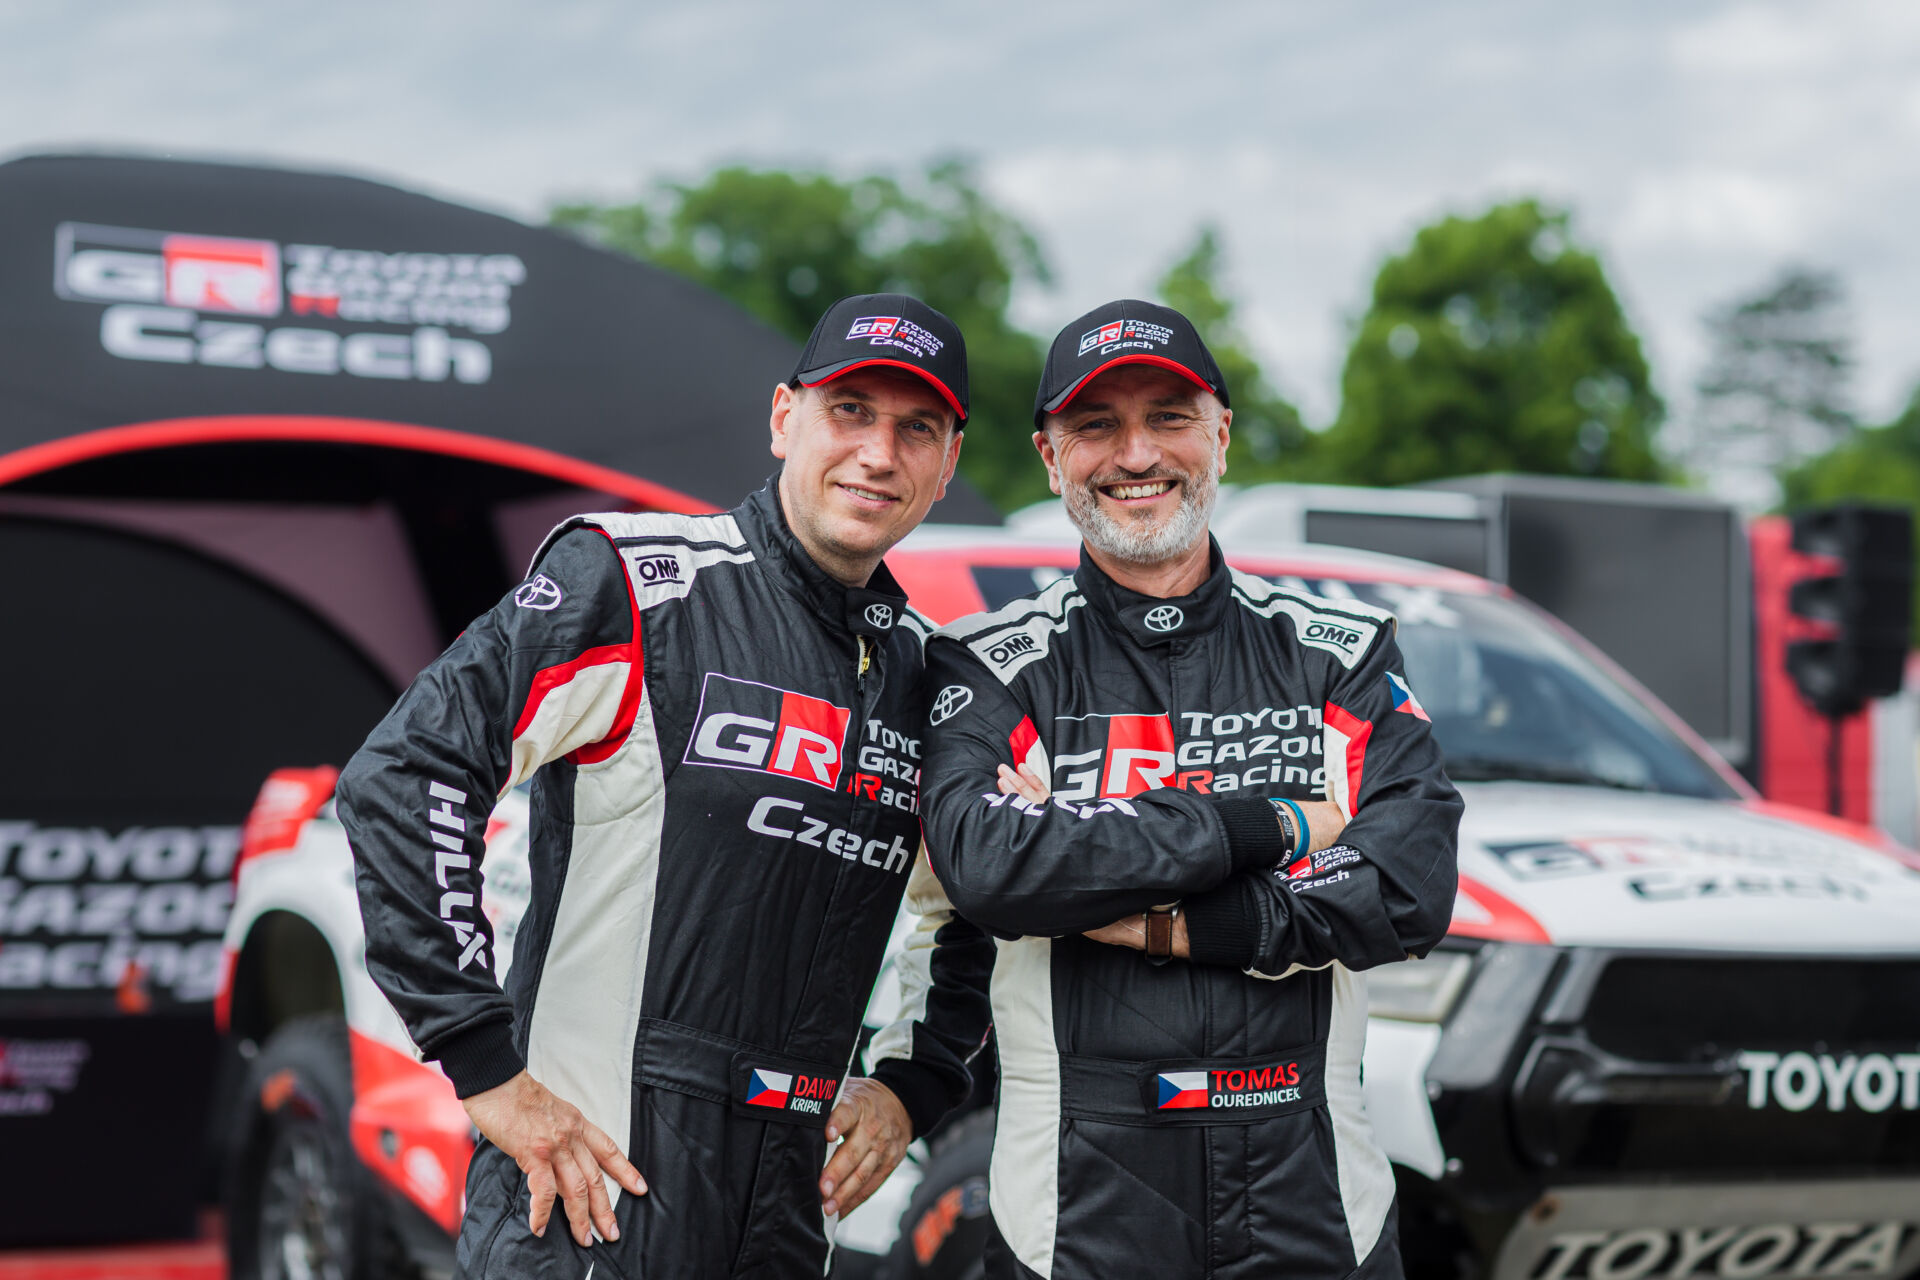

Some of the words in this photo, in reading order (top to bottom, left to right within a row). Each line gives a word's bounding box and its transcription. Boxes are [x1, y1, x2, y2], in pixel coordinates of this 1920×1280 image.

[898, 326, 940, 352] GAZOO
[902, 319, 945, 349] TOYOTA
[1123, 331, 1169, 345] Racing
[1125, 325, 1170, 339] GAZOO
[1126, 319, 1174, 335] TOYOTA
[101, 303, 492, 384] Czech
[869, 336, 924, 359] Czech
[894, 331, 937, 356] Racing
[1101, 340, 1154, 355] Czech
[638, 559, 680, 581] OMP
[1305, 624, 1360, 646] OMP
[989, 635, 1035, 664] OMP
[694, 712, 838, 785] GR
[866, 719, 922, 760] TOYO
[1051, 748, 1176, 801] GR
[846, 771, 919, 816] Raci
[746, 796, 910, 874] Czech
[1311, 844, 1354, 860] TOYO
[1313, 855, 1361, 874] Racing
[429, 780, 488, 972] HILUX
[1289, 869, 1350, 893] Czech
[794, 1074, 837, 1100] DAVID
[1211, 1062, 1300, 1092] TOMAS
[1736, 1050, 1920, 1114] TOYOT
[790, 1096, 823, 1114] KRIPAL
[1211, 1086, 1302, 1108] OUREDNICEK
[1538, 1222, 1900, 1280] TOYOTA
